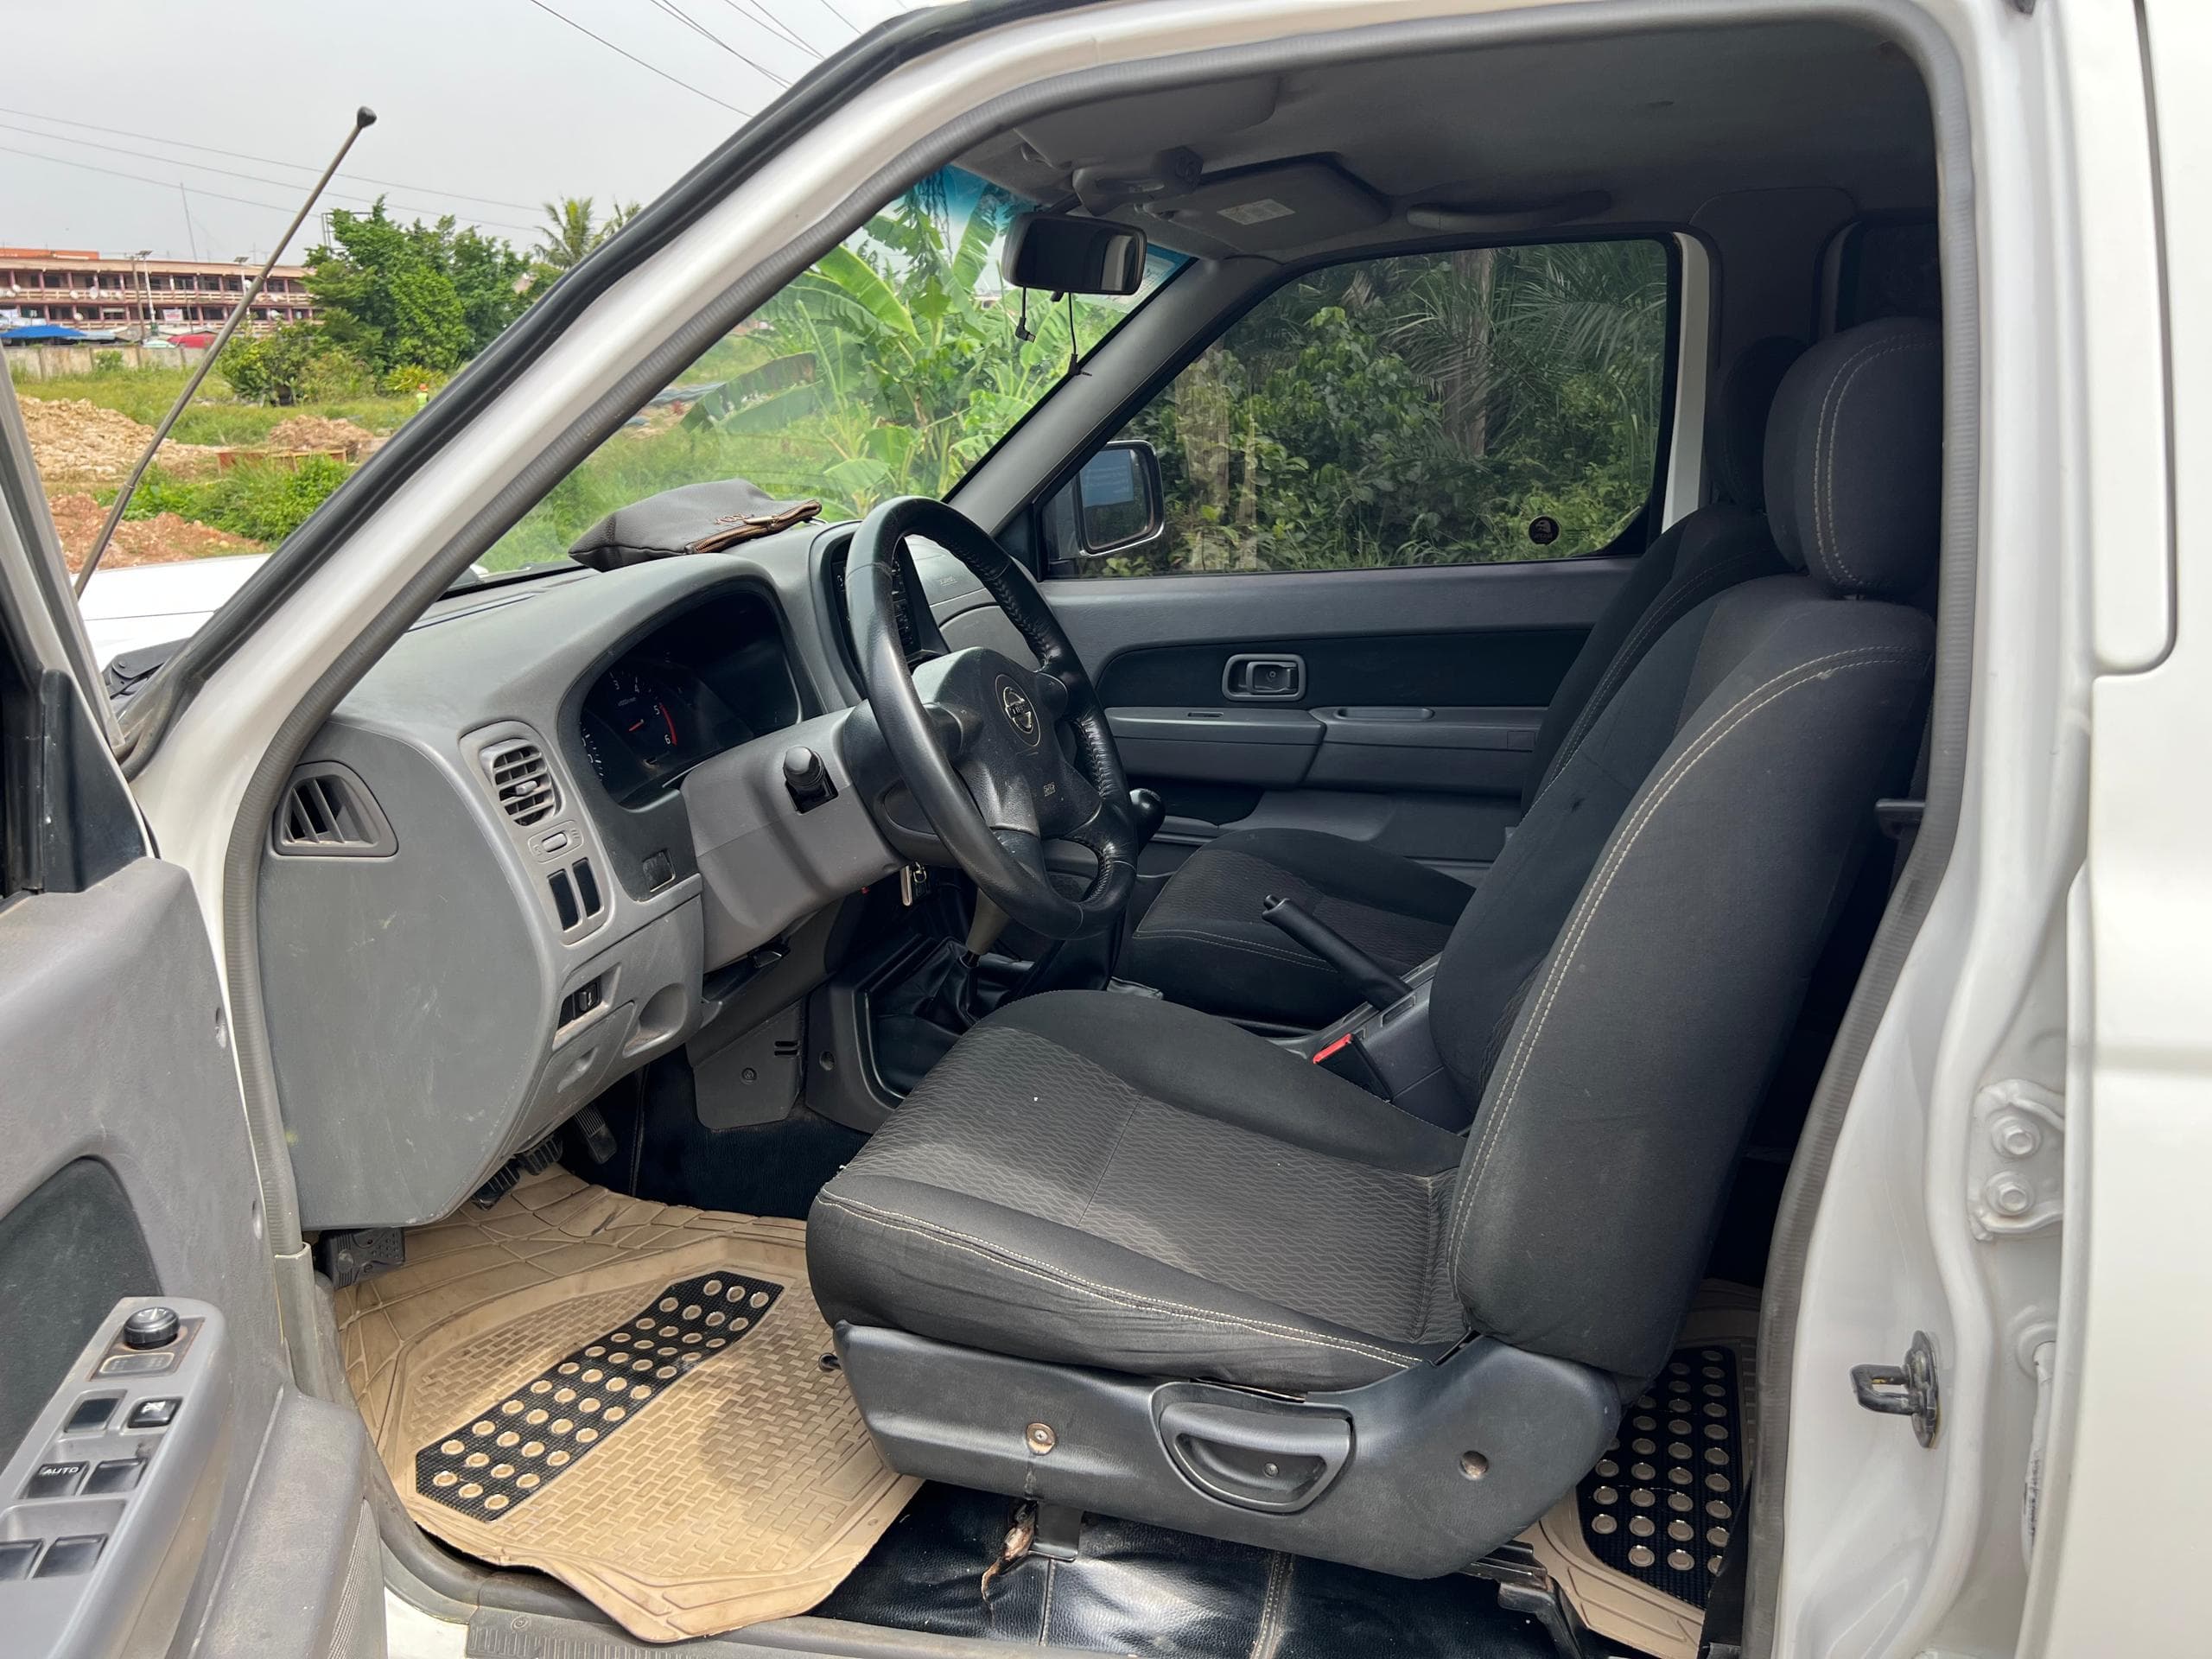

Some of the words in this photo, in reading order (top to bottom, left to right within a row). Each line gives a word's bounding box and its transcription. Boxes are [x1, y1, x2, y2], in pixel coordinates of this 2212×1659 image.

[613, 680, 620, 690] 3
[634, 683, 640, 693] 4
[653, 704, 660, 715] 5
[664, 734, 671, 745] 6
[42, 1466, 79, 1475] AUTO
